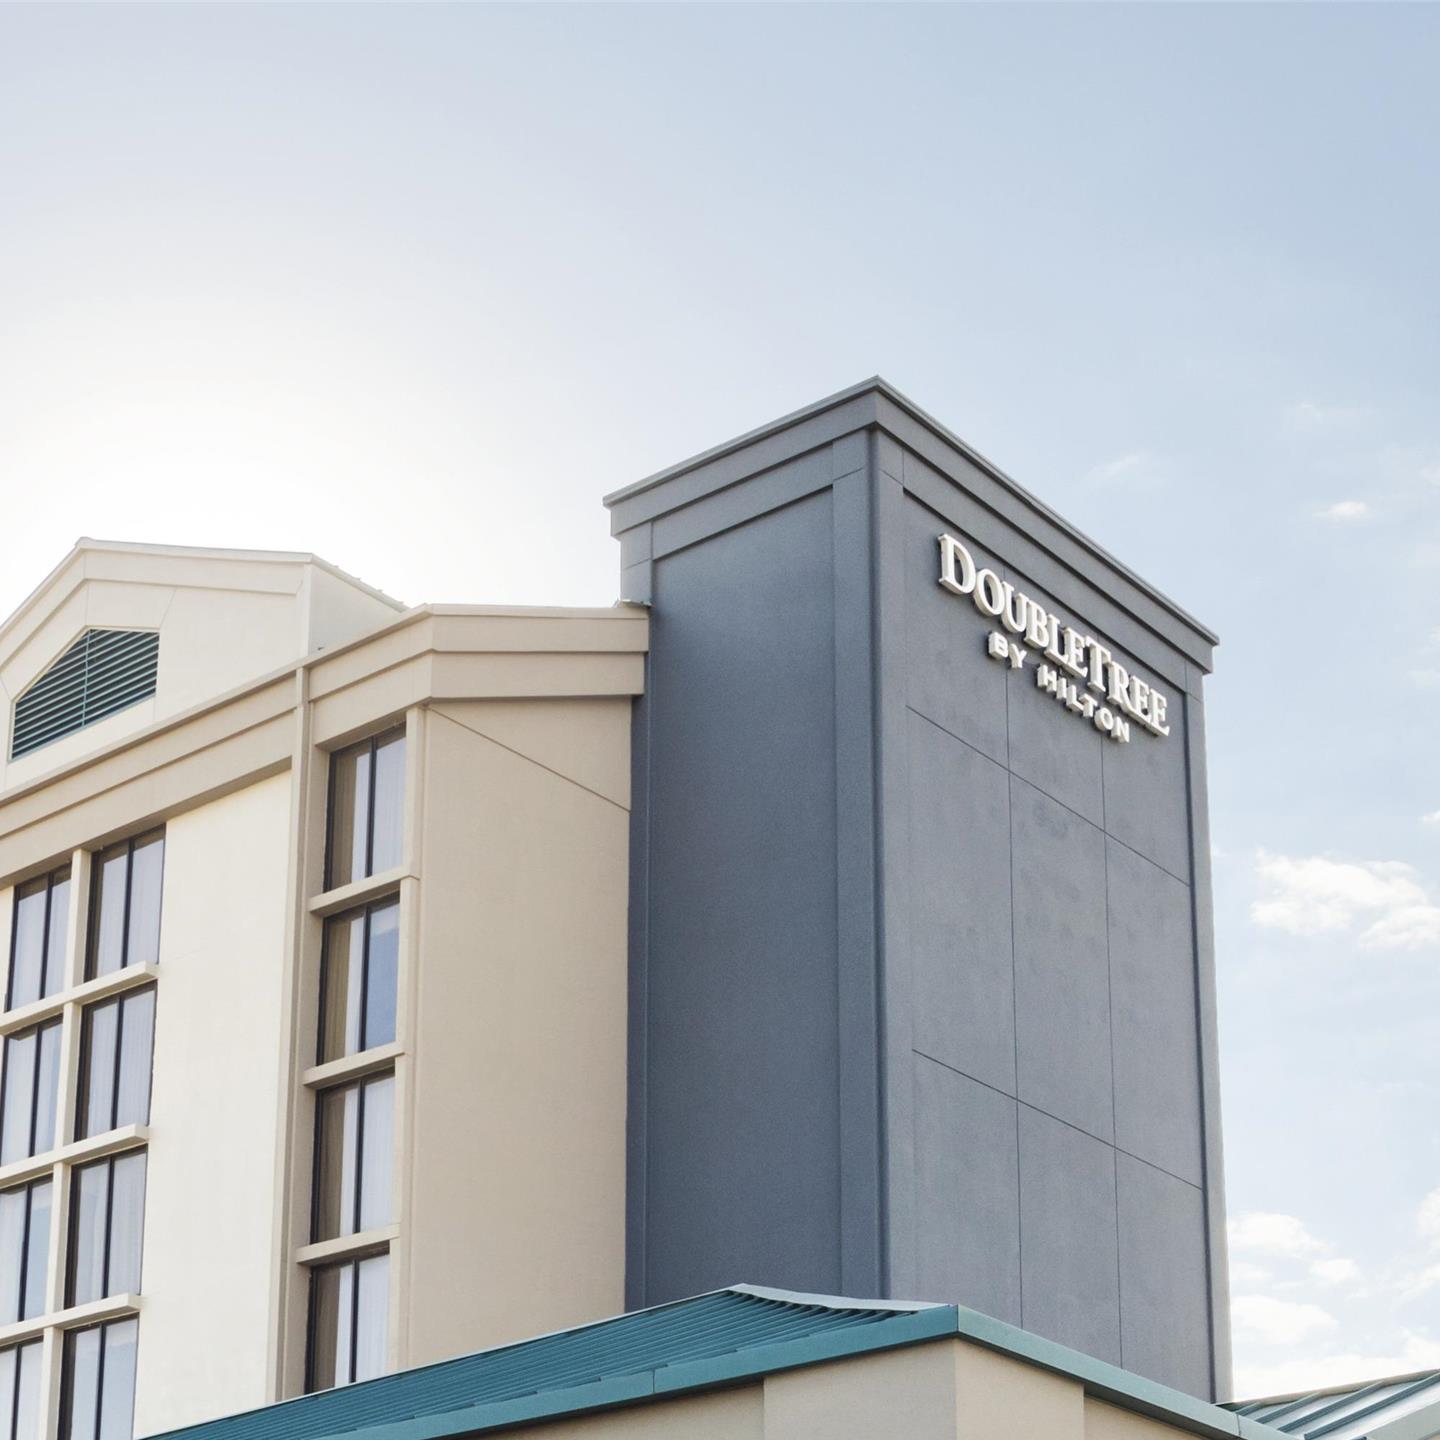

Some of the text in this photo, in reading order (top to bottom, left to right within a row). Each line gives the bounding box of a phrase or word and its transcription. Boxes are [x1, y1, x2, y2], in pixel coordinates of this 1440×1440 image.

[937, 533, 1170, 736] DOUBLETREE
[987, 630, 1130, 743] BY HILTON
